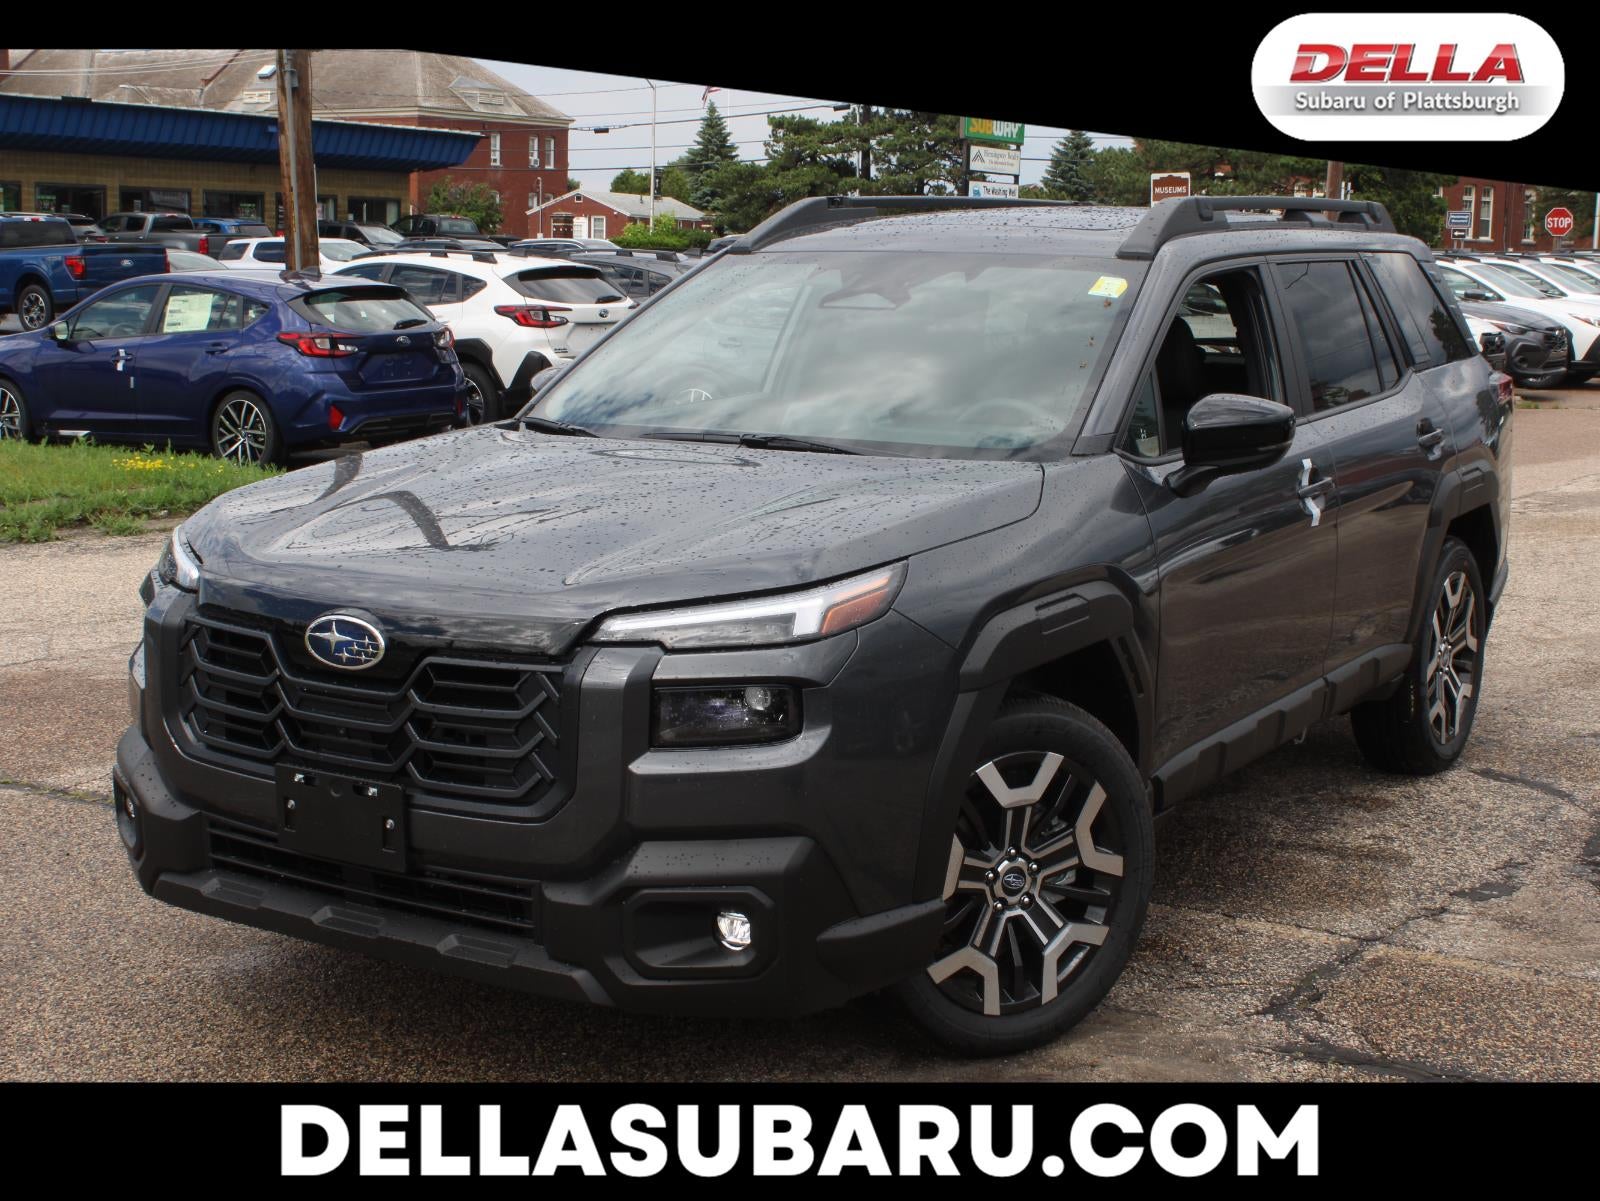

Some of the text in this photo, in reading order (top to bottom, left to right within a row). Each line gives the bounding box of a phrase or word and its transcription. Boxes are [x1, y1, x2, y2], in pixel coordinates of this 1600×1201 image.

[969, 118, 1021, 138] SUBWAY
[1154, 186, 1187, 194] MUSEUMS
[1547, 217, 1571, 228] STOP
